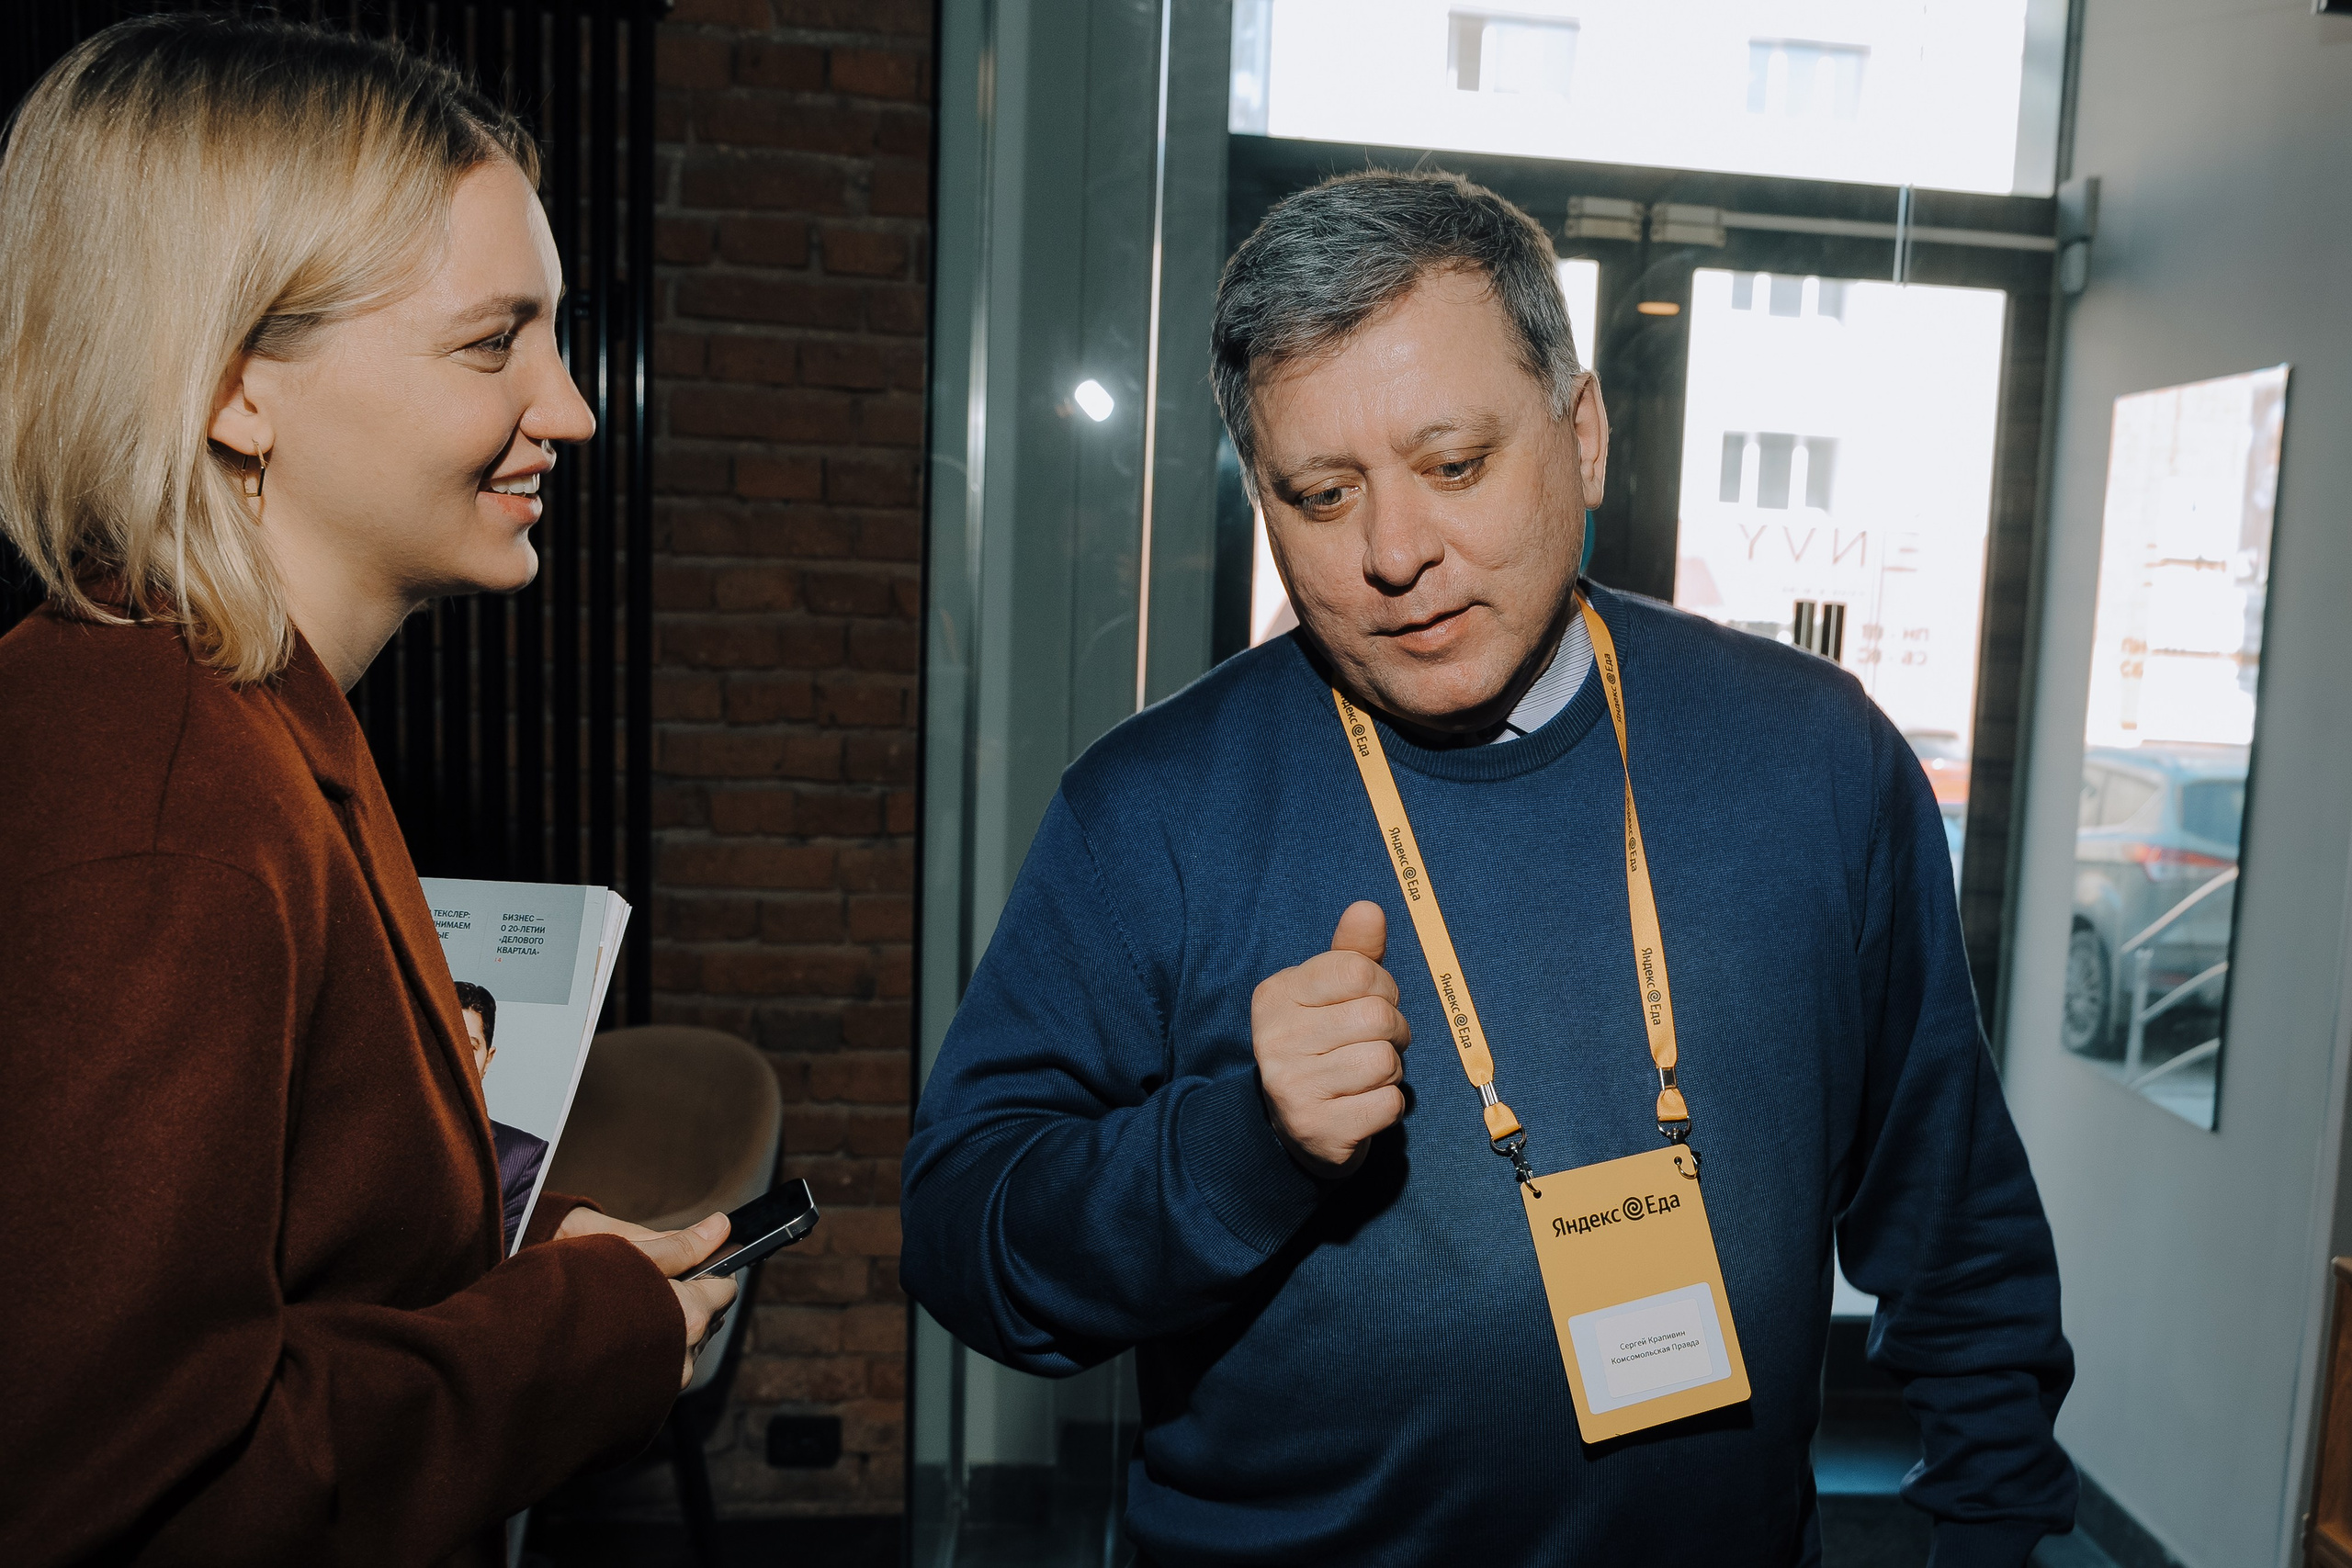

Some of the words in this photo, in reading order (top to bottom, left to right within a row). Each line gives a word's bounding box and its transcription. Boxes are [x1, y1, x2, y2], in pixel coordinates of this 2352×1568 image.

[1604, 653, 1614, 672] Еда
[1340, 694, 1358, 725] декс
[1356, 736, 1370, 757] Еда
[1388, 827, 1409, 867] Яндекс
[1407, 879, 1421, 902] Еда
[434, 909, 471, 919] ТЕКСЛЕР:
[434, 919, 471, 930] НИМАЕМ
[503, 913, 535, 922] БИЗНЕС
[508, 924, 546, 934] 20-ЛЕТИИ
[1642, 947, 1656, 988] Яндекс
[1650, 1003, 1662, 1026] Еда
[1440, 973, 1461, 1014] Яндекс
[1458, 1026, 1472, 1049] Еда
[1552, 1206, 1622, 1238] Яндекс
[1645, 1193, 1681, 1215] Еда
[1620, 1337, 1647, 1350] Сергей
[1648, 1330, 1686, 1345] Крапивин
[1611, 1346, 1670, 1365] Комсомольская
[1671, 1339, 1700, 1351] Правда
